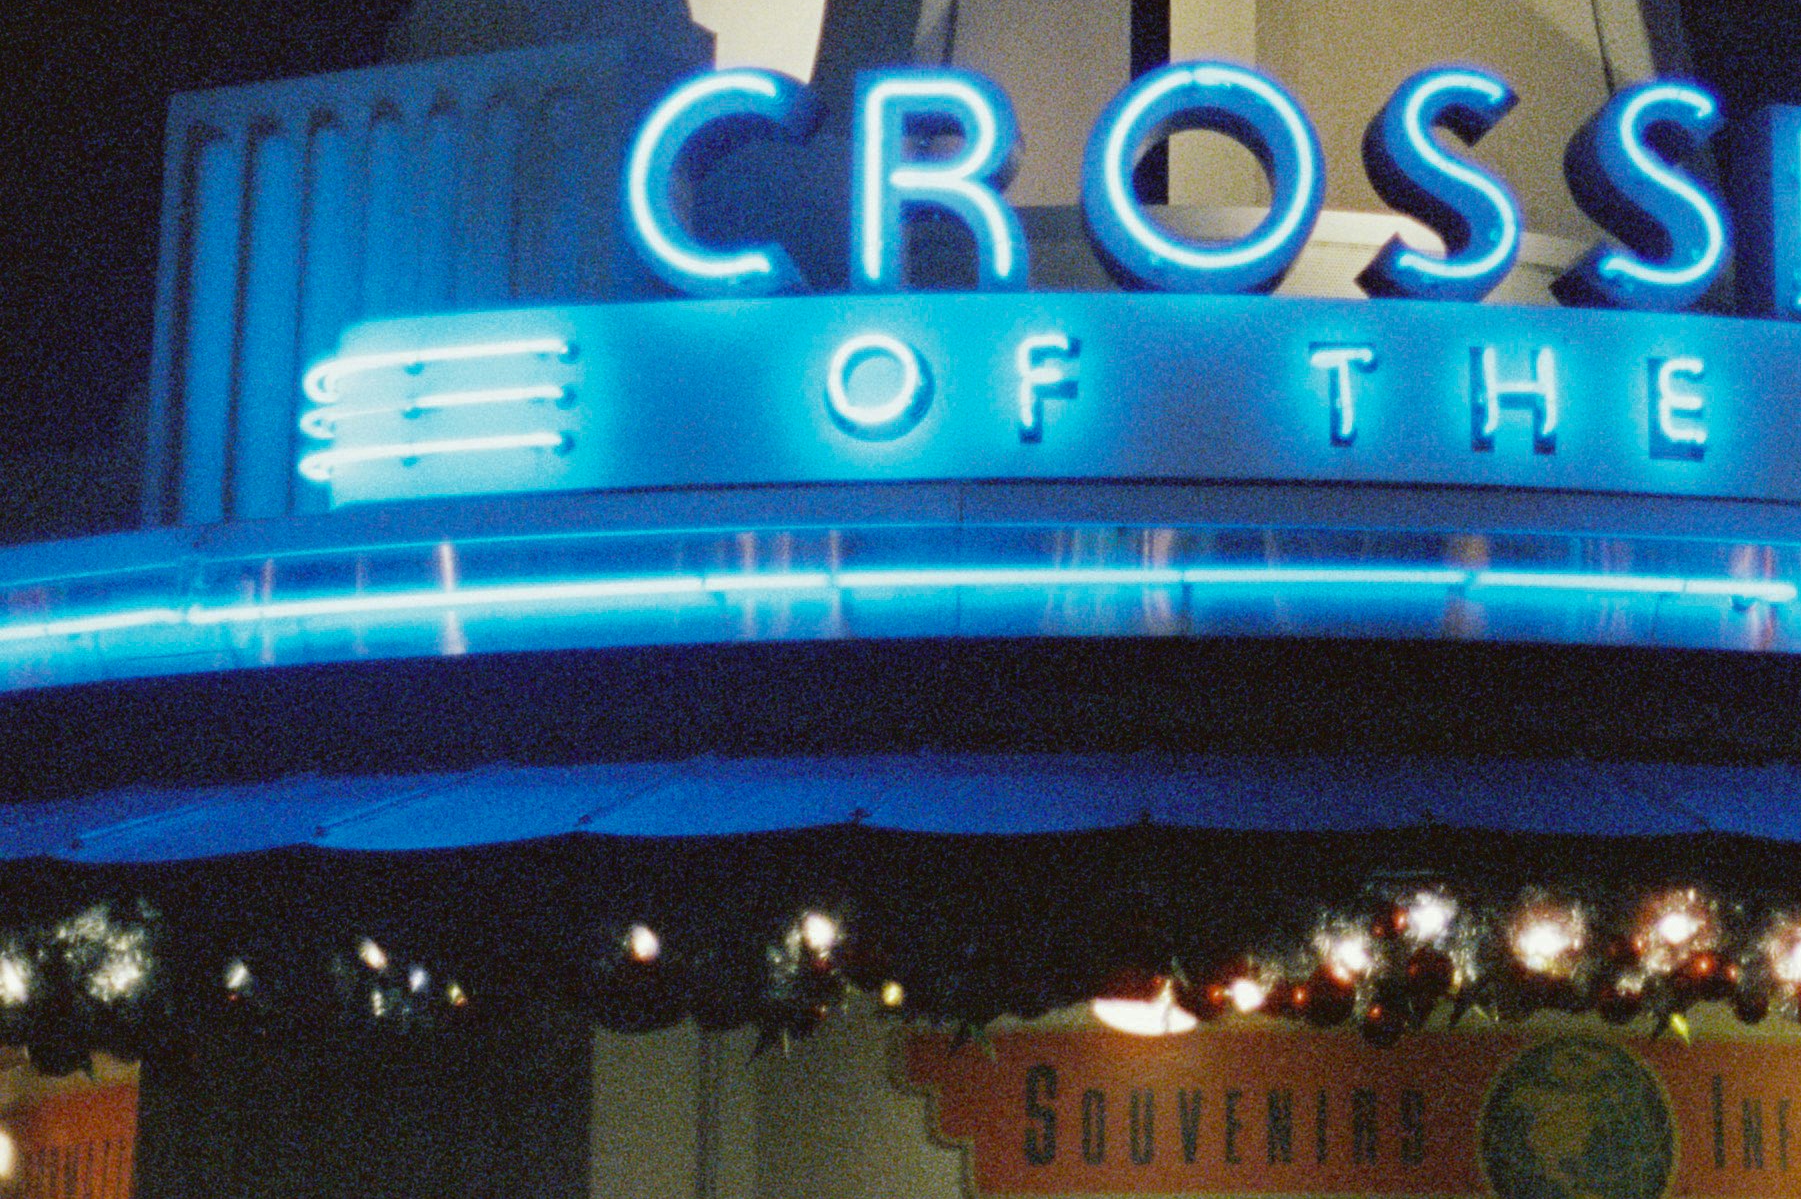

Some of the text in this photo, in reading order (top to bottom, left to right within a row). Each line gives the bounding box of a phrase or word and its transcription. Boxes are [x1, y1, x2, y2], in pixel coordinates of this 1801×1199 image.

[825, 328, 1082, 444] OF
[1308, 340, 1706, 462] THE
[1022, 1063, 1425, 1166] SOUVENIRS
